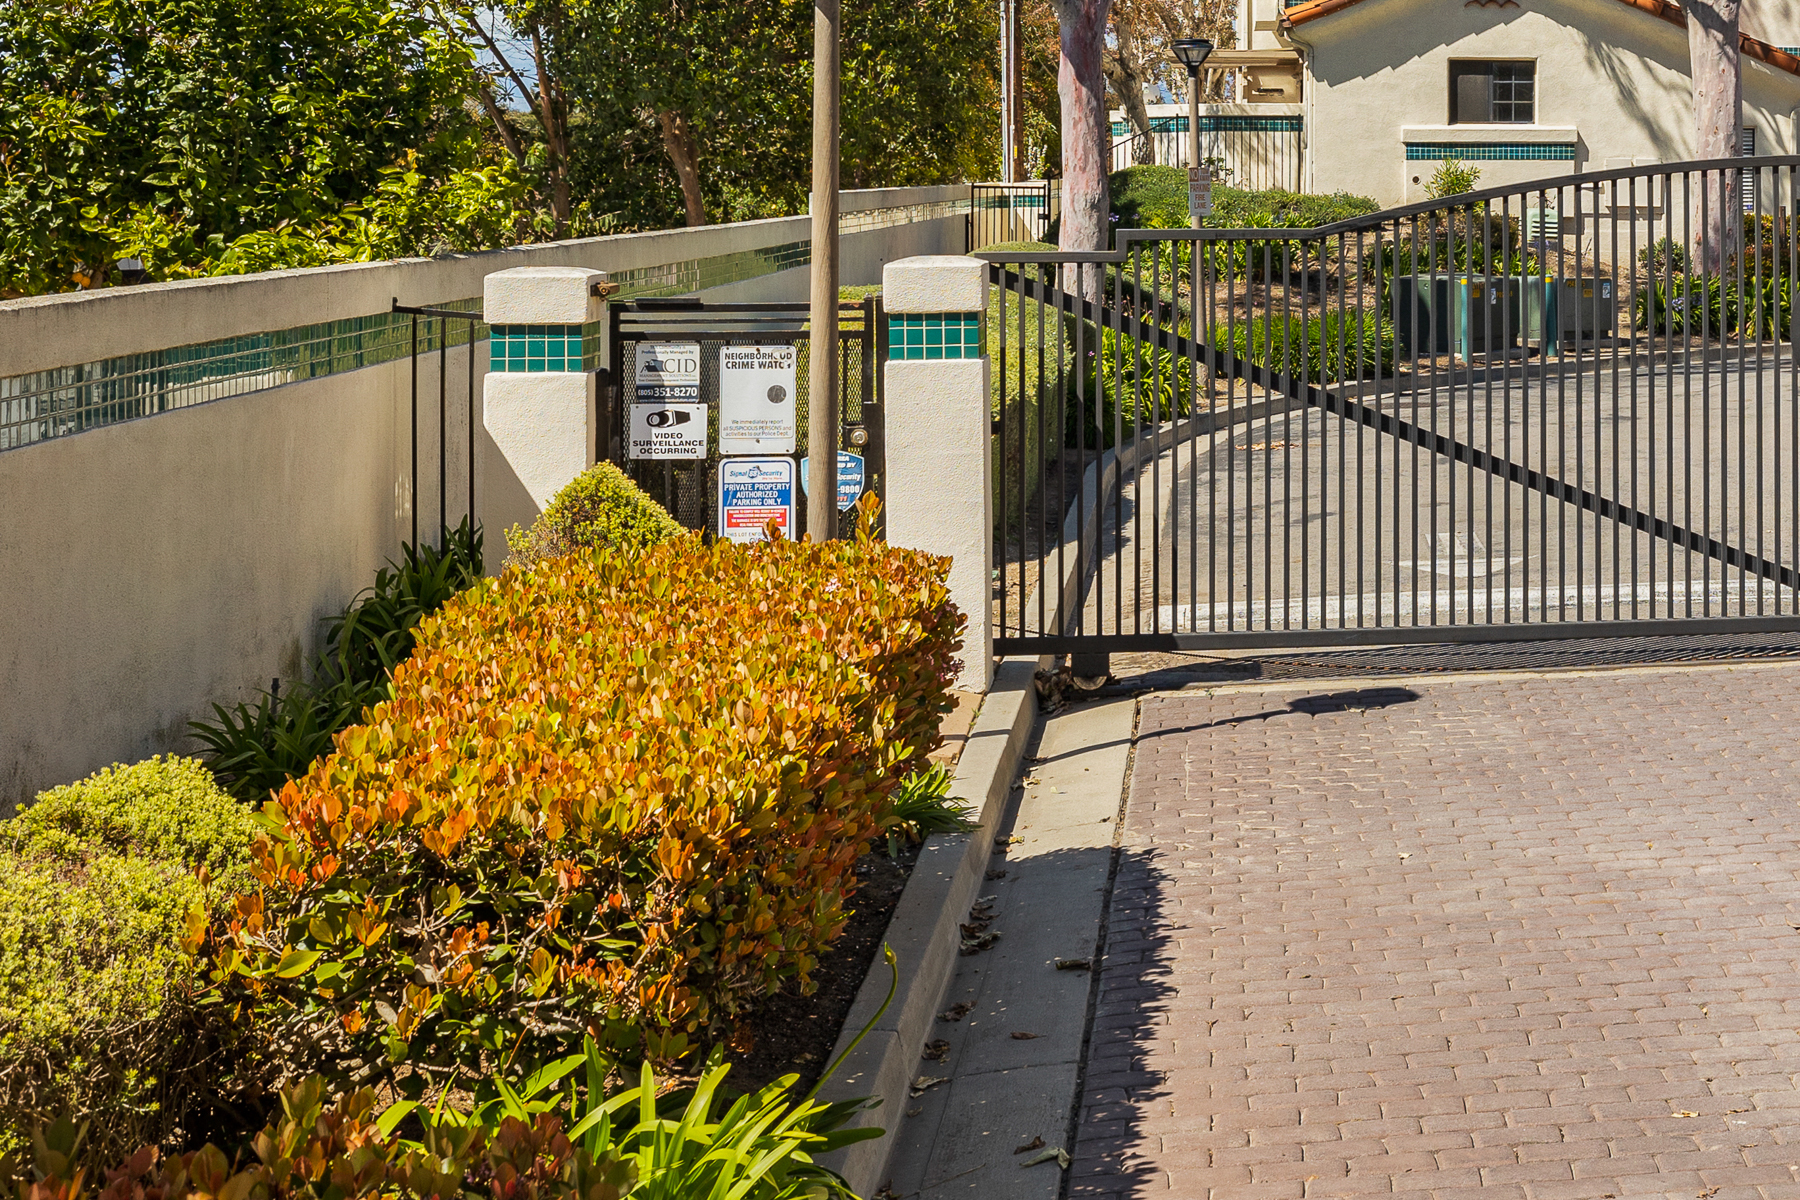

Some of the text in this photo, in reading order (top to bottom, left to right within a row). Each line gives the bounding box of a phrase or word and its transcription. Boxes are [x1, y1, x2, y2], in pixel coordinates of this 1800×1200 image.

[1190, 183, 1211, 192] PARKING
[1194, 193, 1206, 201] FIRE
[1193, 201, 1207, 209] LANE
[663, 358, 697, 374] CID
[725, 361, 755, 369] CRIME
[653, 387, 698, 397] 351-8270
[639, 447, 697, 455] OCCURRING
[729, 470, 748, 478] Signal
[758, 469, 783, 477] Security
[724, 483, 790, 491] PRIVATE PROPERTY
[736, 491, 779, 499] AUTHORIZED
[732, 498, 782, 506] PARKING ONLY
